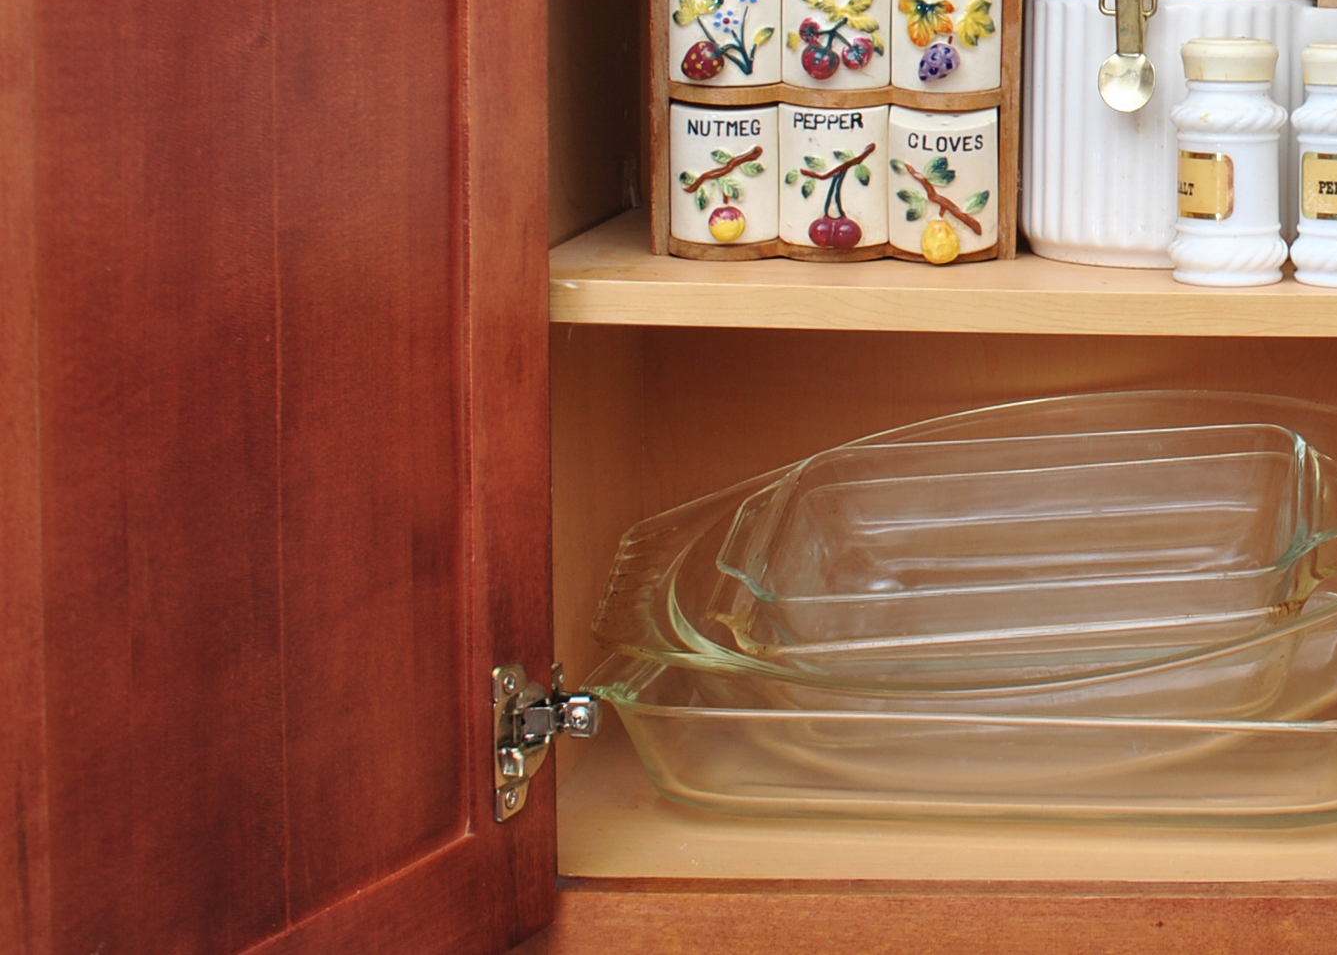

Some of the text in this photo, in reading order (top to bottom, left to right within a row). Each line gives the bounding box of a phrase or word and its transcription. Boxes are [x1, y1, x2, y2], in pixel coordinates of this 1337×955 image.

[687, 118, 761, 137] NUTMEG
[793, 112, 864, 131] PEPPER
[908, 132, 984, 153] CLOVES
